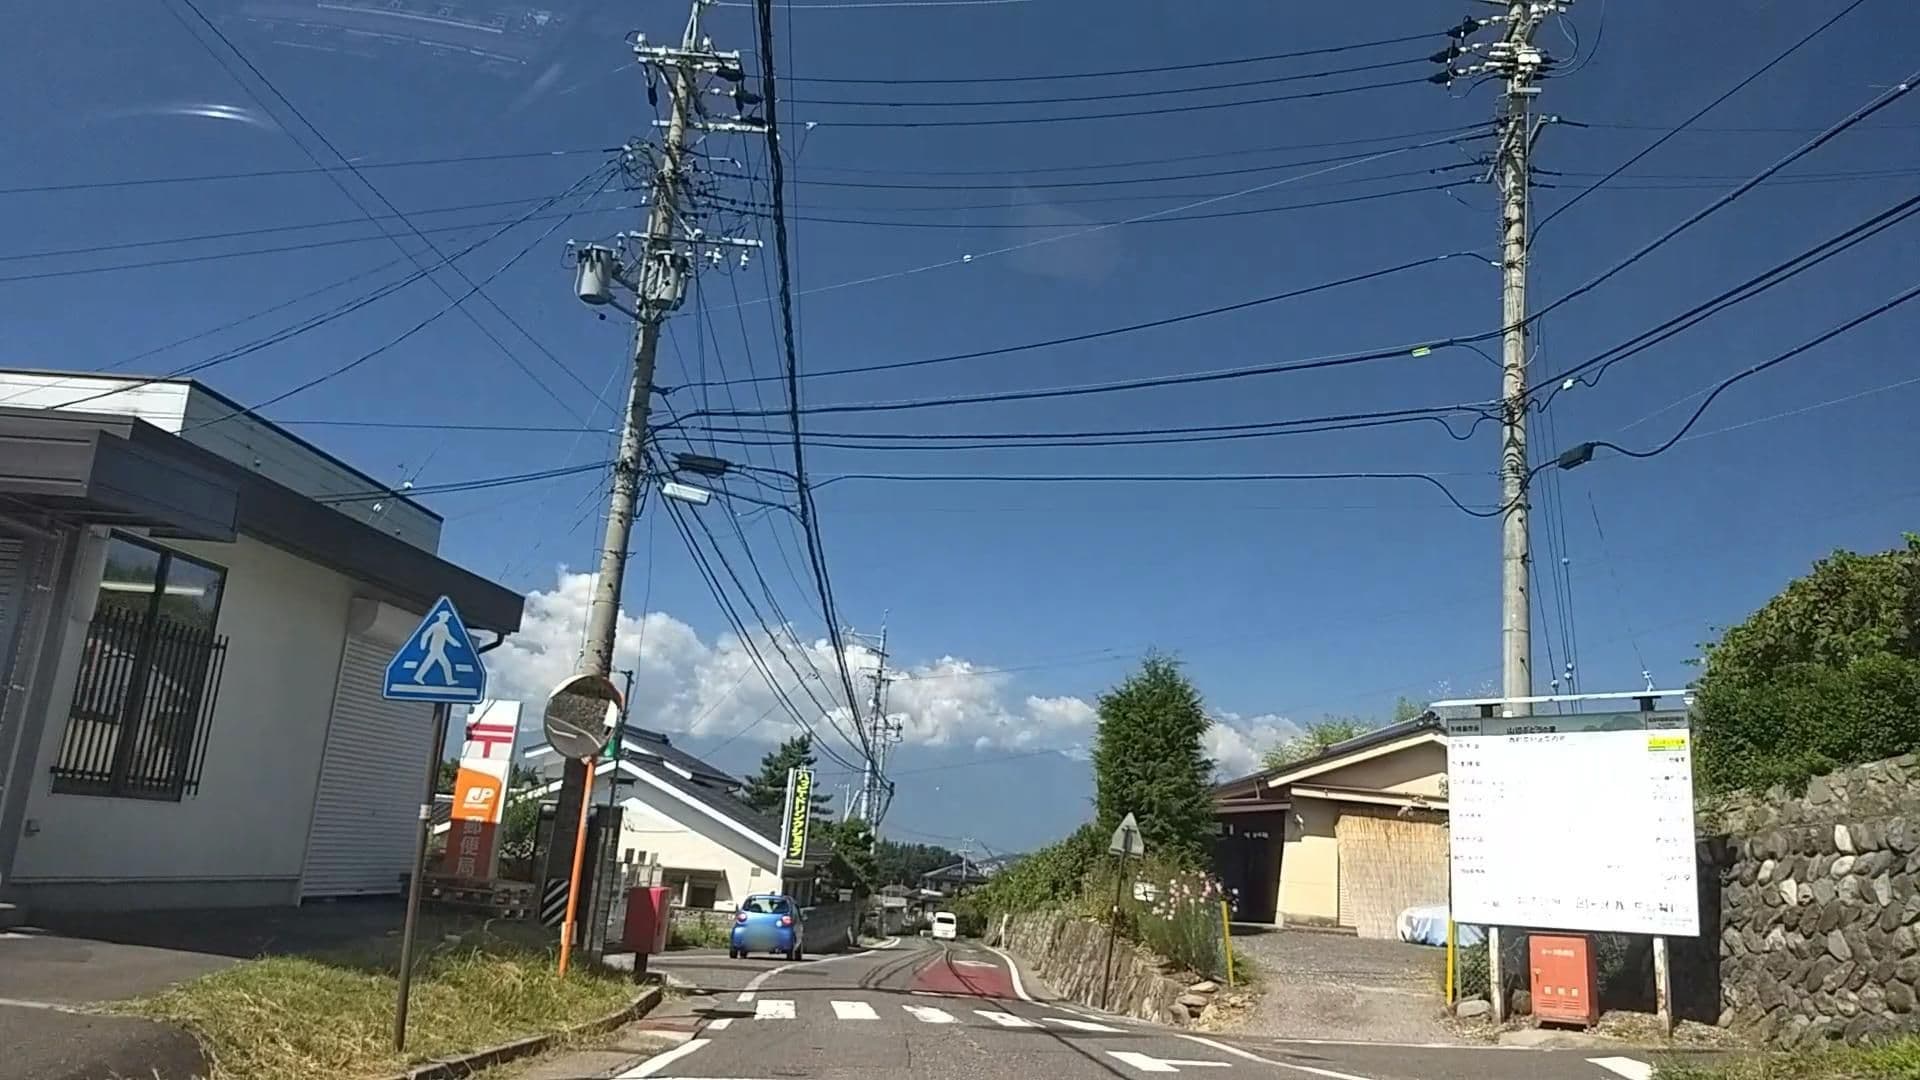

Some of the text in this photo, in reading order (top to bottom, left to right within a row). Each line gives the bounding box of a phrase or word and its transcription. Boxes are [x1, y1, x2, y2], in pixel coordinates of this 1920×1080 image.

[465, 787, 495, 803] JP
[456, 816, 482, 877] 郵便局
